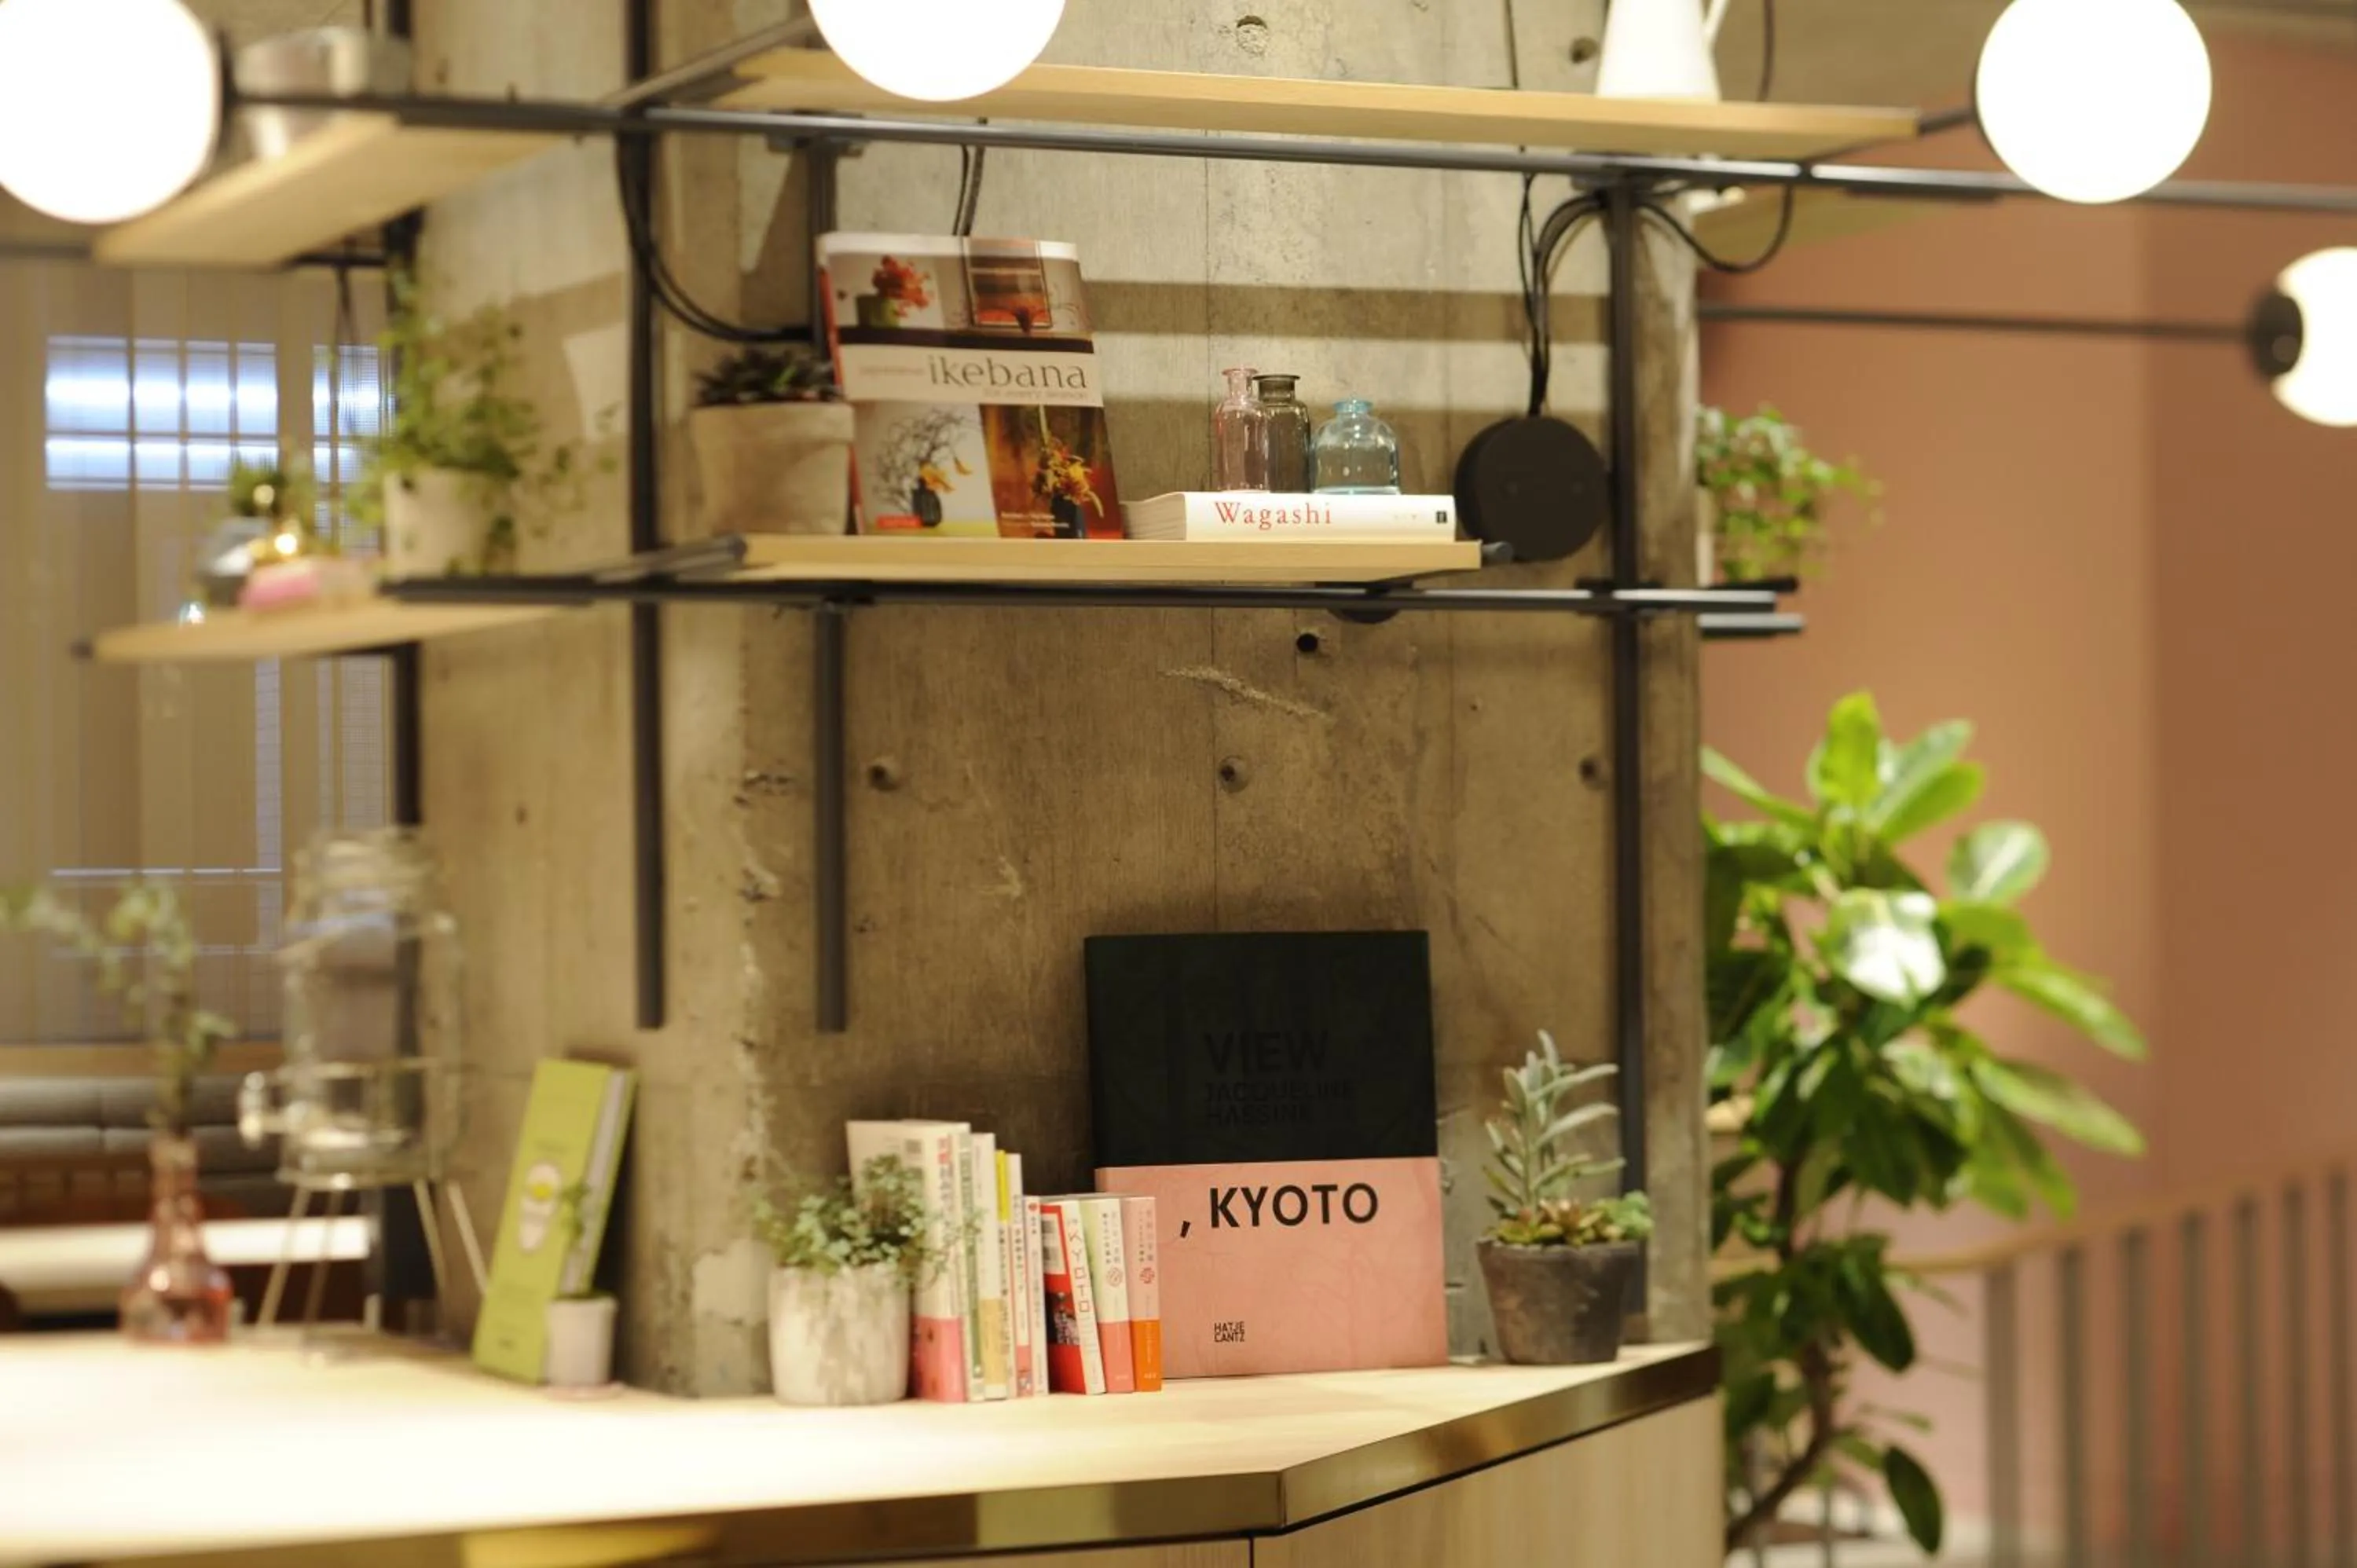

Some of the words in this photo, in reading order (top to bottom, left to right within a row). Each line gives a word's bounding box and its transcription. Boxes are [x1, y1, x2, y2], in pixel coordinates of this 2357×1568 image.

[927, 355, 1088, 389] ikebana
[1214, 500, 1332, 531] Wagashi
[1203, 1028, 1329, 1075] VIEW
[1209, 1182, 1380, 1229] KYOTO
[1068, 1229, 1090, 1313] KYOTO
[1214, 1321, 1244, 1332] HATJE
[1214, 1332, 1244, 1343] CANTZ
